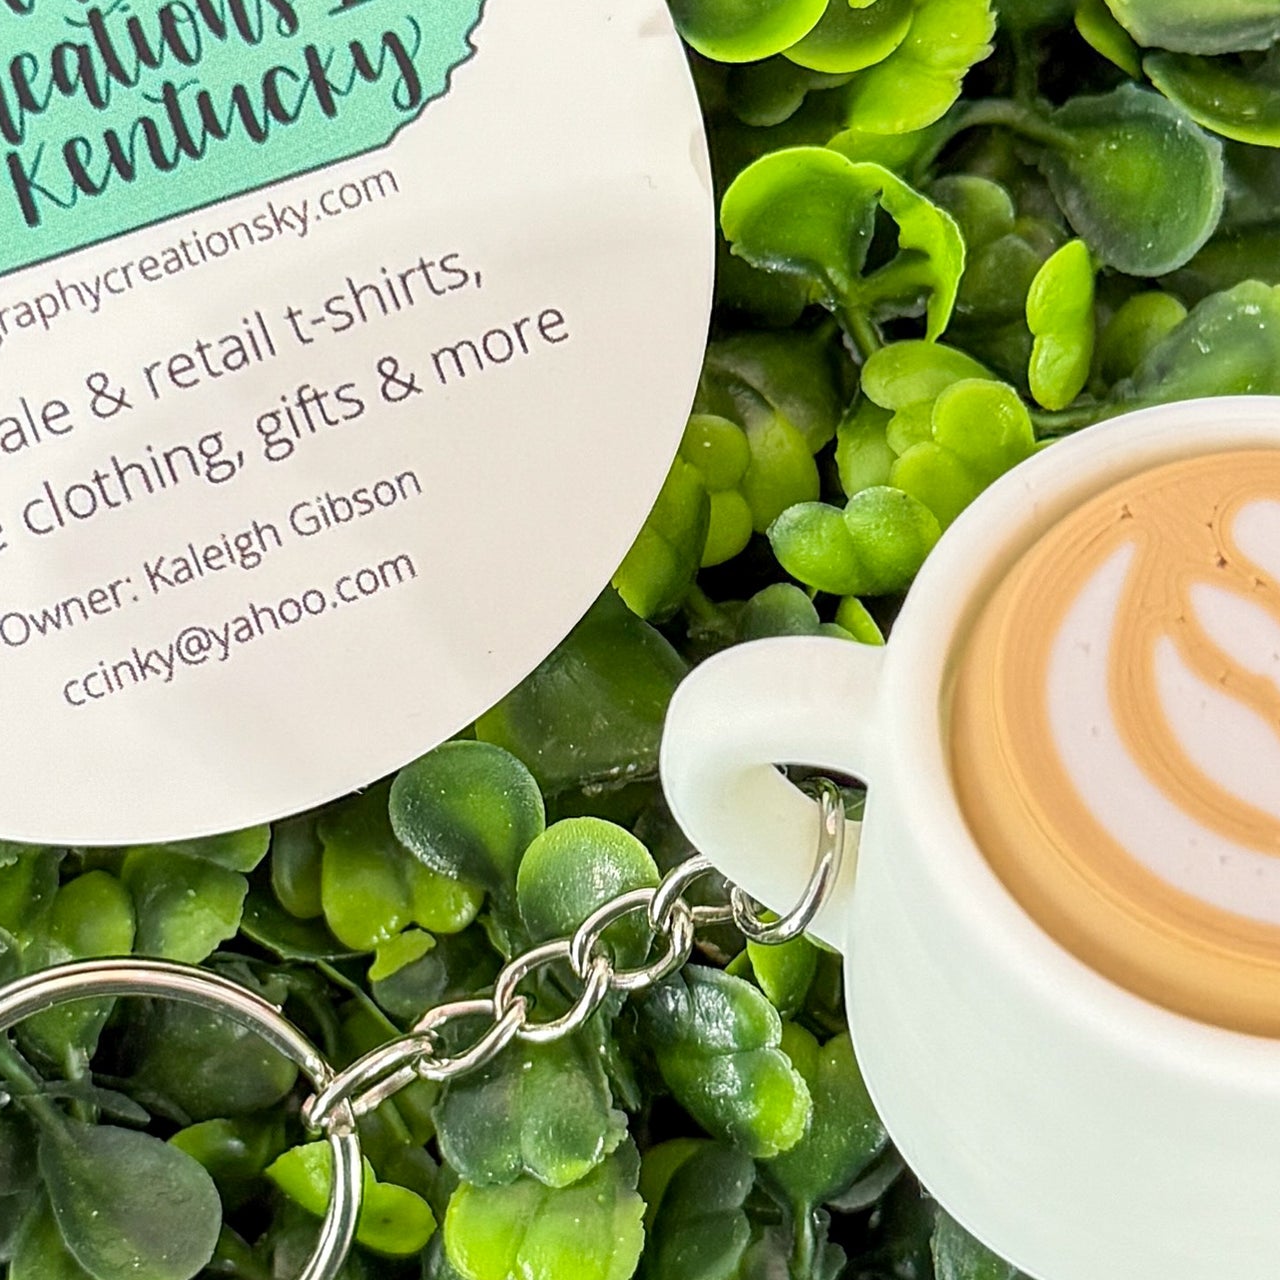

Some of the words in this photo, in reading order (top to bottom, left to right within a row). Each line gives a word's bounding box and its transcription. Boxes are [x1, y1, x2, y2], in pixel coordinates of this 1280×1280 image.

[87, 371, 132, 420] &
[142, 311, 277, 400] retail
[286, 245, 484, 358] t-shirts,
[23, 424, 244, 538] clothing,
[256, 378, 365, 461] gifts
[380, 356, 423, 403] &
[432, 301, 569, 386] more
[143, 518, 283, 597] Kaleigh
[290, 466, 422, 540] Gibson
[62, 548, 418, 708] ccinky@yahoo.com
